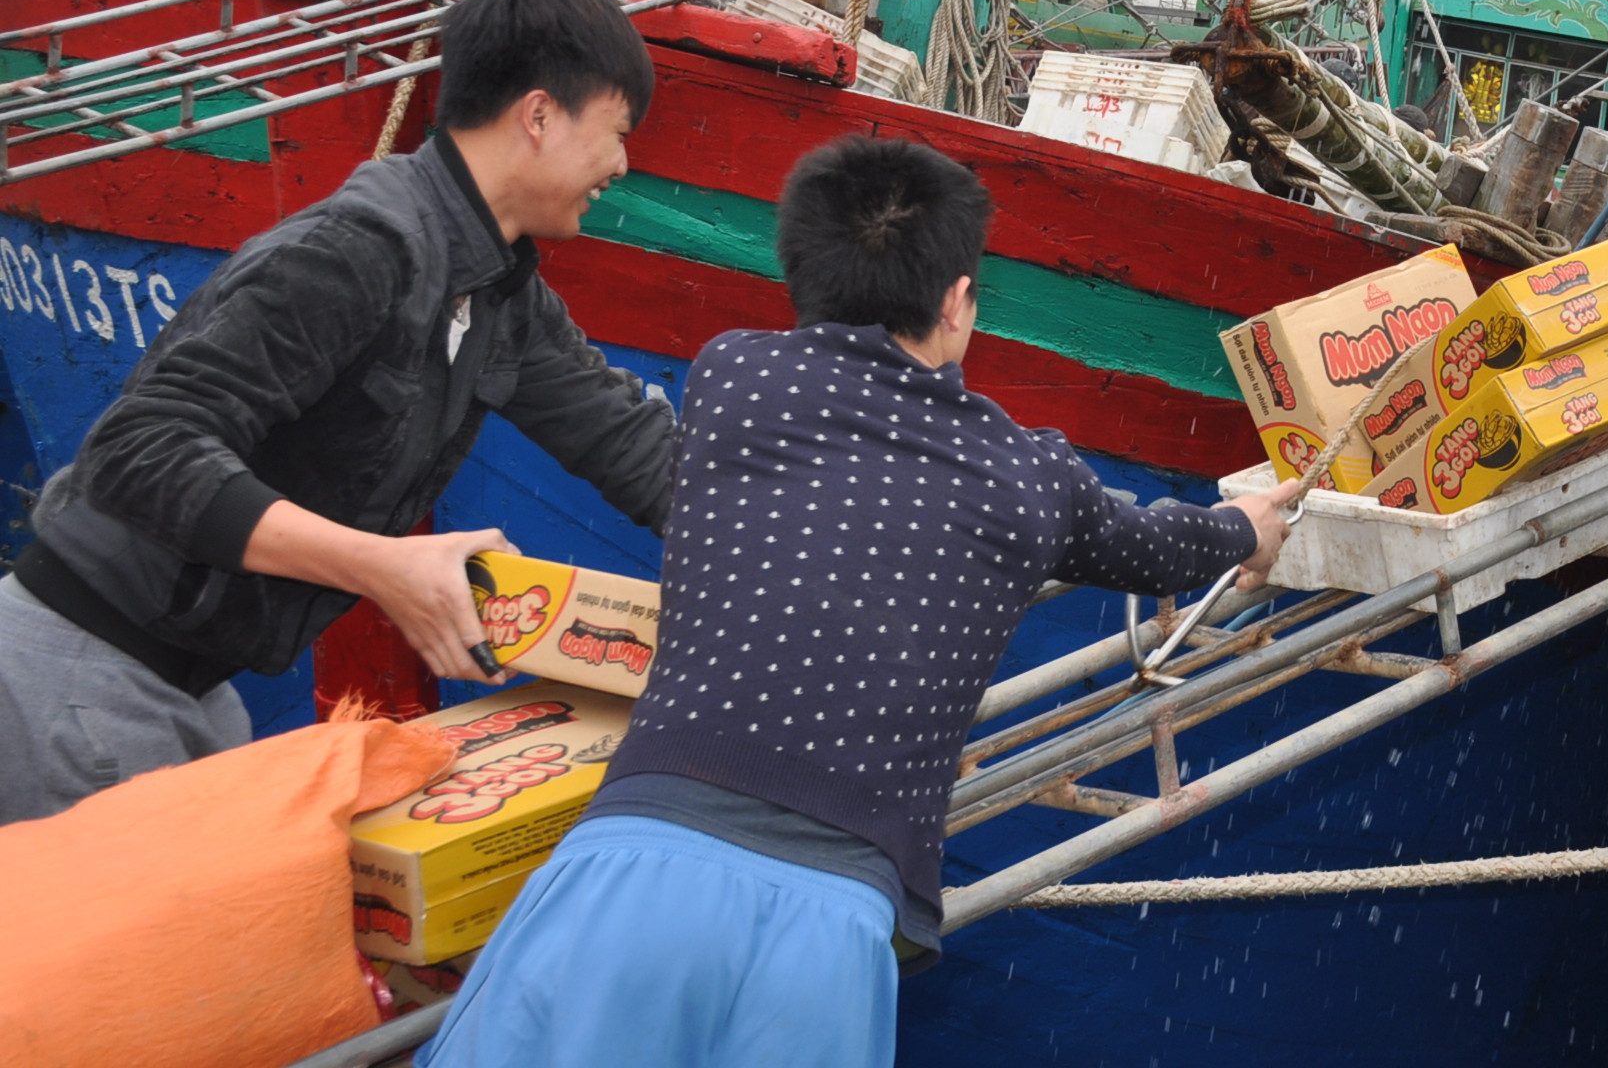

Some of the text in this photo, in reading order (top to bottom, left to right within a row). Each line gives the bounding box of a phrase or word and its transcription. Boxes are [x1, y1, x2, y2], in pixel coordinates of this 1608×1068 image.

[1528, 274, 1560, 295] Mum
[1553, 261, 1589, 284] Ngon
[1560, 310, 1582, 334] 3
[1320, 324, 1395, 385] Mum
[1384, 298, 1458, 354] Ngon
[1252, 322, 1277, 366] Mum
[1269, 363, 1297, 411] Ngon
[1441, 363, 1469, 400] 3
[1523, 366, 1555, 390] Mum
[1550, 354, 1586, 377] Ngon
[1363, 405, 1397, 440] Mum
[1389, 380, 1426, 413] Ngon
[1561, 409, 1584, 435] 3
[1278, 432, 1308, 467] 3
[1379, 478, 1417, 507] Ngon
[1432, 461, 1462, 499] 3
[518, 585, 551, 634] 3
[559, 629, 653, 675] Mum Ngon
[409, 792, 505, 823] 3
